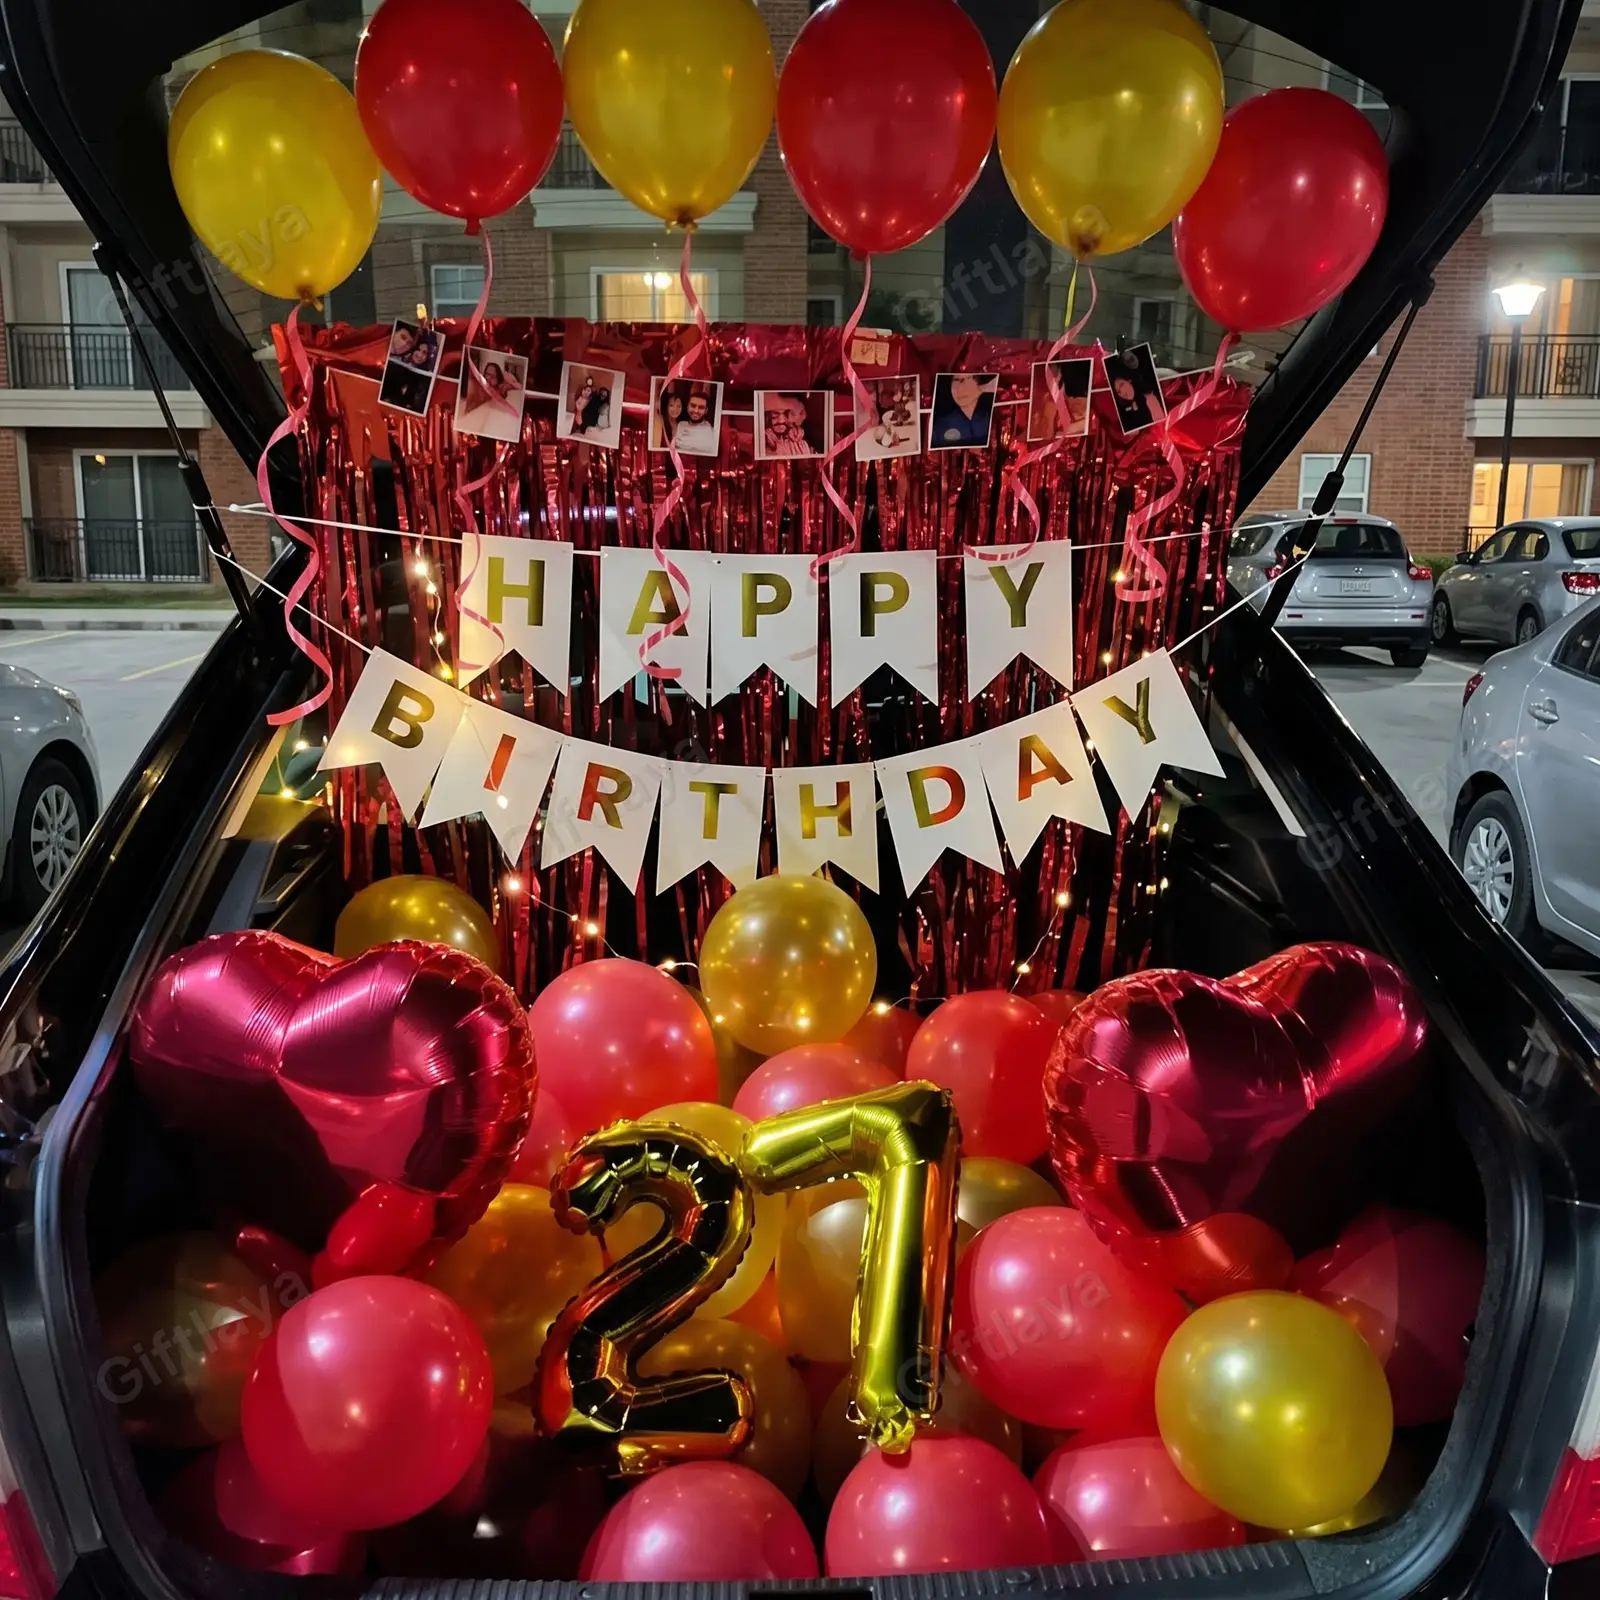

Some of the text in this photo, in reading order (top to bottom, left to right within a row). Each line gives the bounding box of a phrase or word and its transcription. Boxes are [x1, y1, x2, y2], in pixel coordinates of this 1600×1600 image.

[486, 556, 1045, 638] HAPPY
[371, 676, 1157, 841] BIRTHDAY
[530, 1079, 963, 1477] 27
